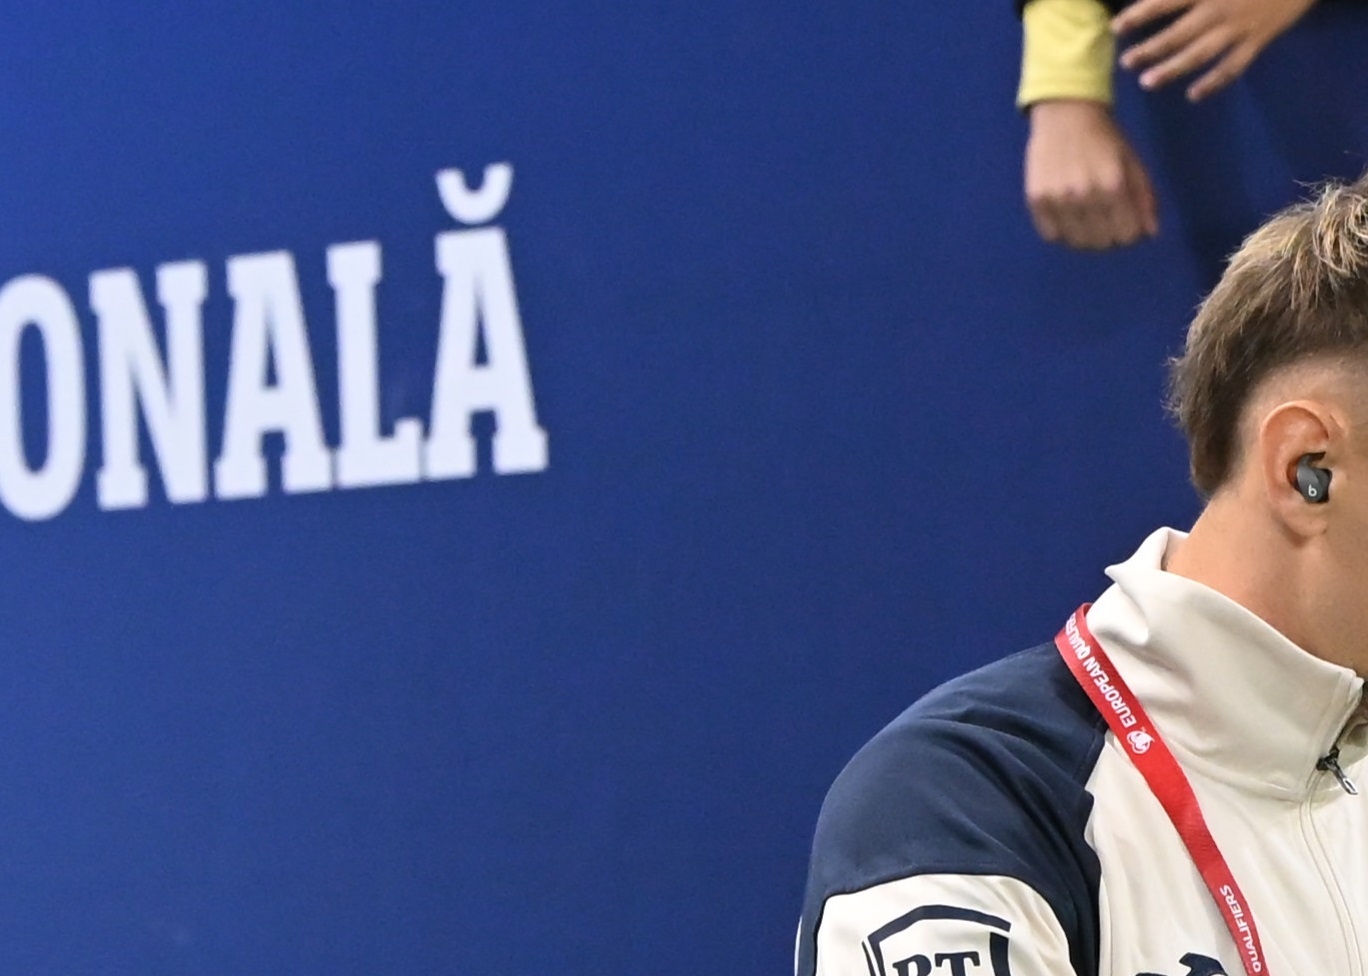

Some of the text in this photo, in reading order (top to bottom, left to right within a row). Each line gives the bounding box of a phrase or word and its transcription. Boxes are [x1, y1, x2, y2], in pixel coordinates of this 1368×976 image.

[0, 162, 548, 522] ONALĂ
[1083, 656, 1137, 729] EUROPEAN
[1219, 884, 1262, 973] QUALIFIERS
